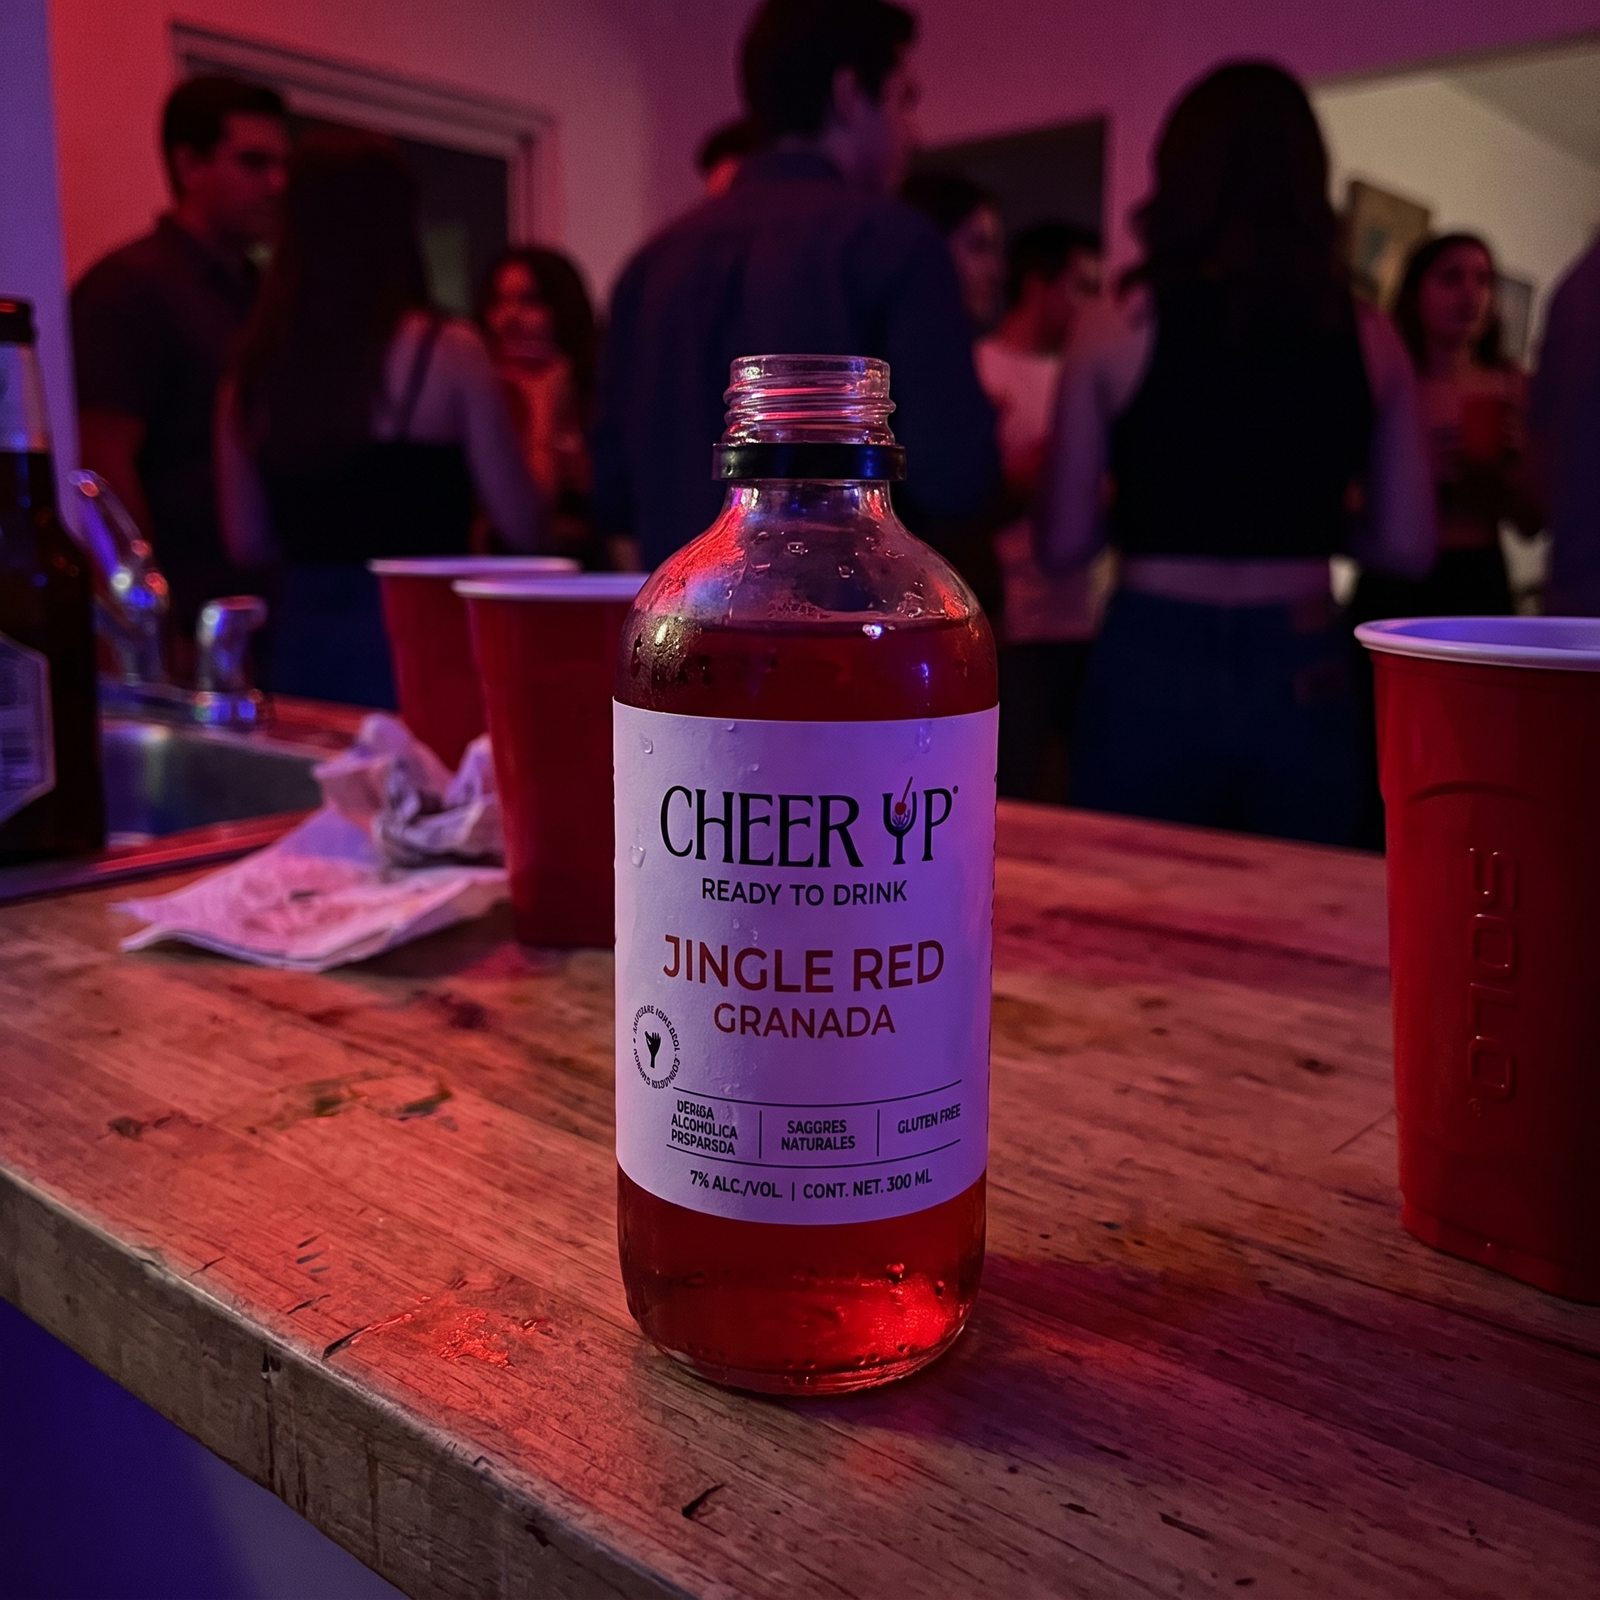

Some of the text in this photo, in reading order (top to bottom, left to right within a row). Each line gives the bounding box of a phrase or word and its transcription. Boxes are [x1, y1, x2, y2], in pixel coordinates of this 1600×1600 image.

[660, 785, 864, 868] CHEER
[702, 877, 908, 906] READY TO DRINK
[663, 934, 944, 993] JINGLE RED
[713, 1002, 896, 1039] GRANADA
[897, 1103, 961, 1134] GLUTEN FREE
[781, 1136, 855, 1151] NATURALES
[690, 1170, 709, 1188] 7%
[803, 1183, 849, 1199] CONT.
[853, 1179, 884, 1197] NET.
[886, 1173, 911, 1193] 300
[914, 1168, 933, 1187] ML
